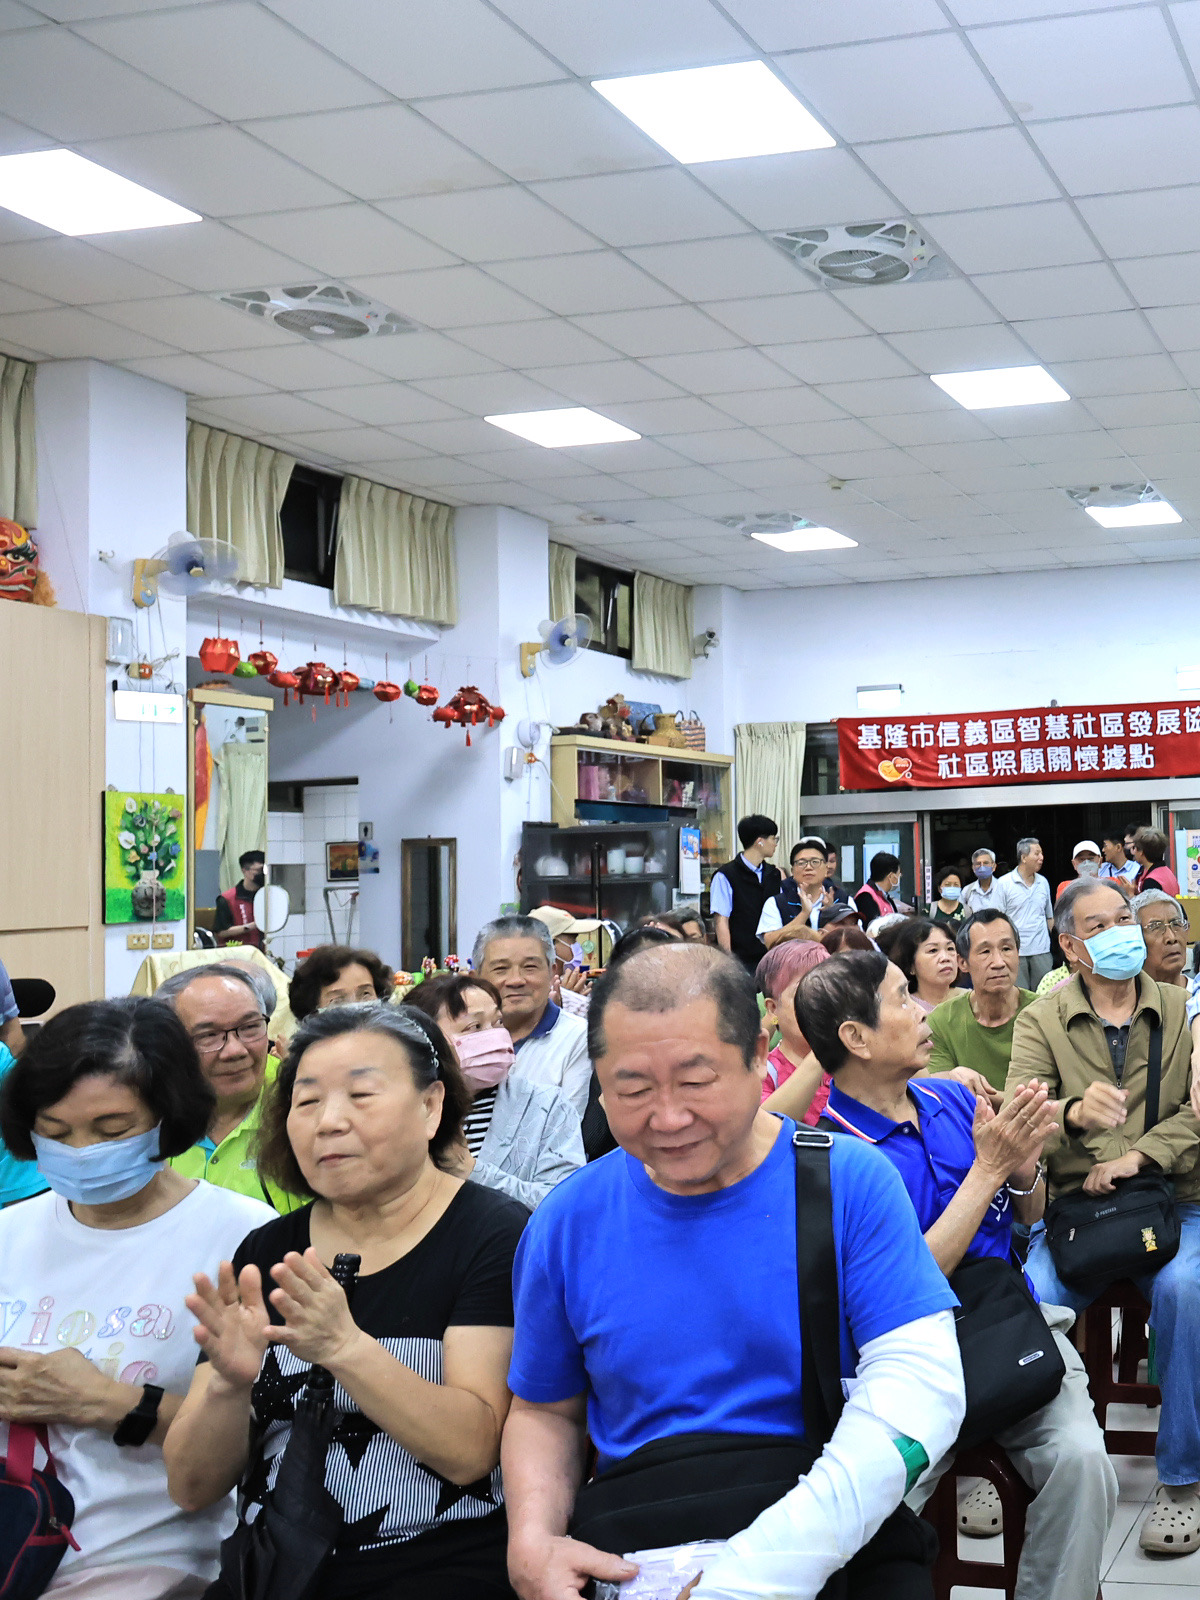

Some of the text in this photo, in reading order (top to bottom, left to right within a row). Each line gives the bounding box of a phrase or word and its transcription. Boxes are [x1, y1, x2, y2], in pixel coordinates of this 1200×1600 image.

[937, 742, 1155, 780] 社區照顧關懷據點
